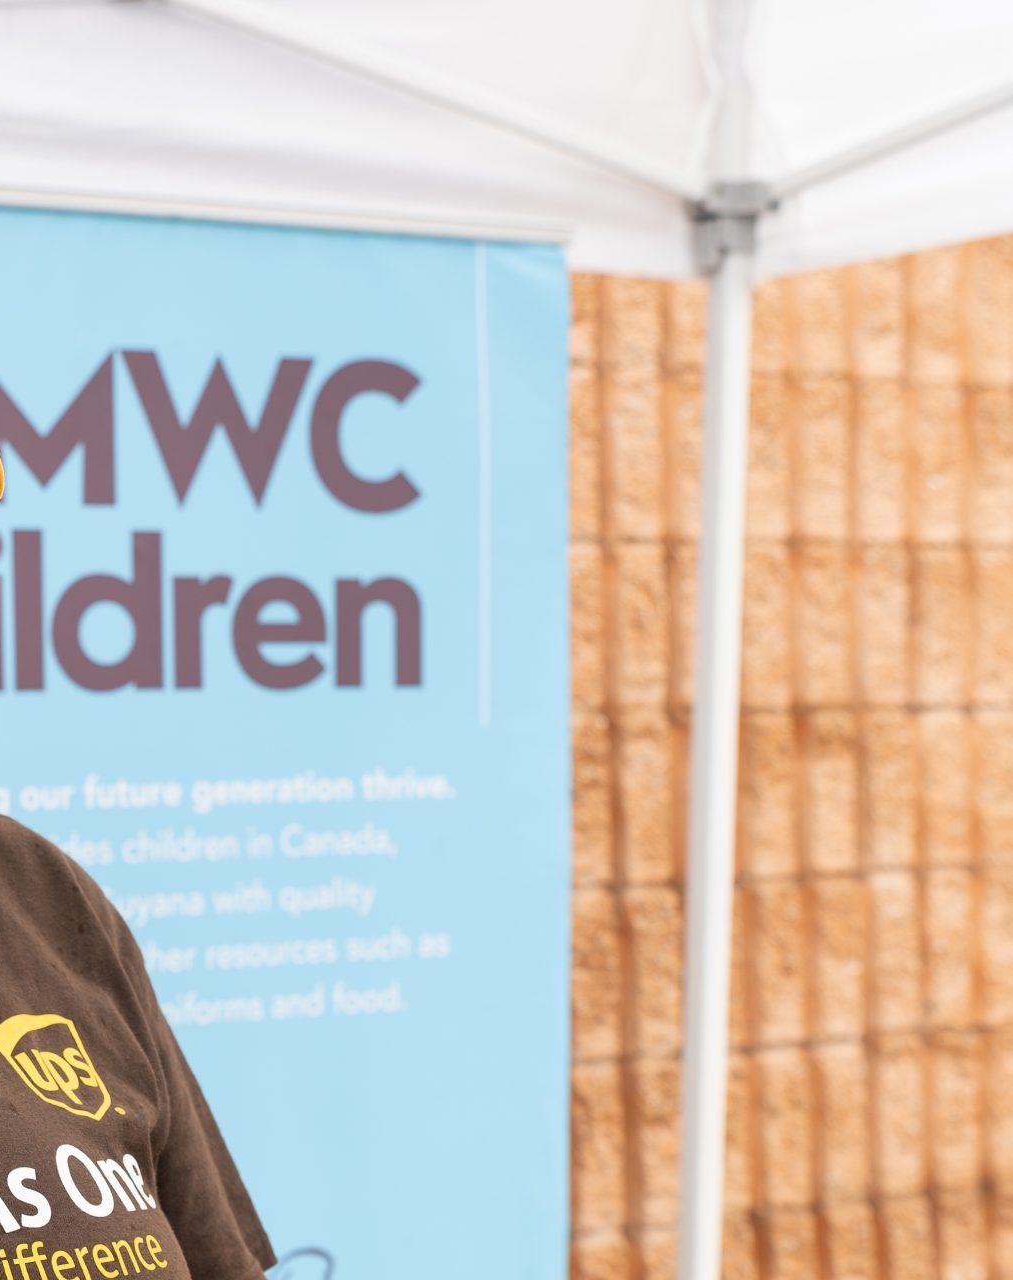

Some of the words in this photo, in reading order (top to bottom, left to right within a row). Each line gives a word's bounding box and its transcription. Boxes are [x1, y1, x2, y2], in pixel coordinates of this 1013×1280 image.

[20, 784, 76, 811] our
[84, 773, 182, 809] future
[191, 770, 354, 814] generation
[122, 827, 239, 864] children
[246, 826, 274, 859] in
[210, 881, 272, 914] with
[279, 875, 376, 917] quality
[205, 938, 338, 970] resources
[346, 928, 411, 963] such
[418, 933, 451, 958] as
[271, 983, 326, 1018] and
[13, 1046, 97, 1106] ups
[55, 1144, 156, 1217] One
